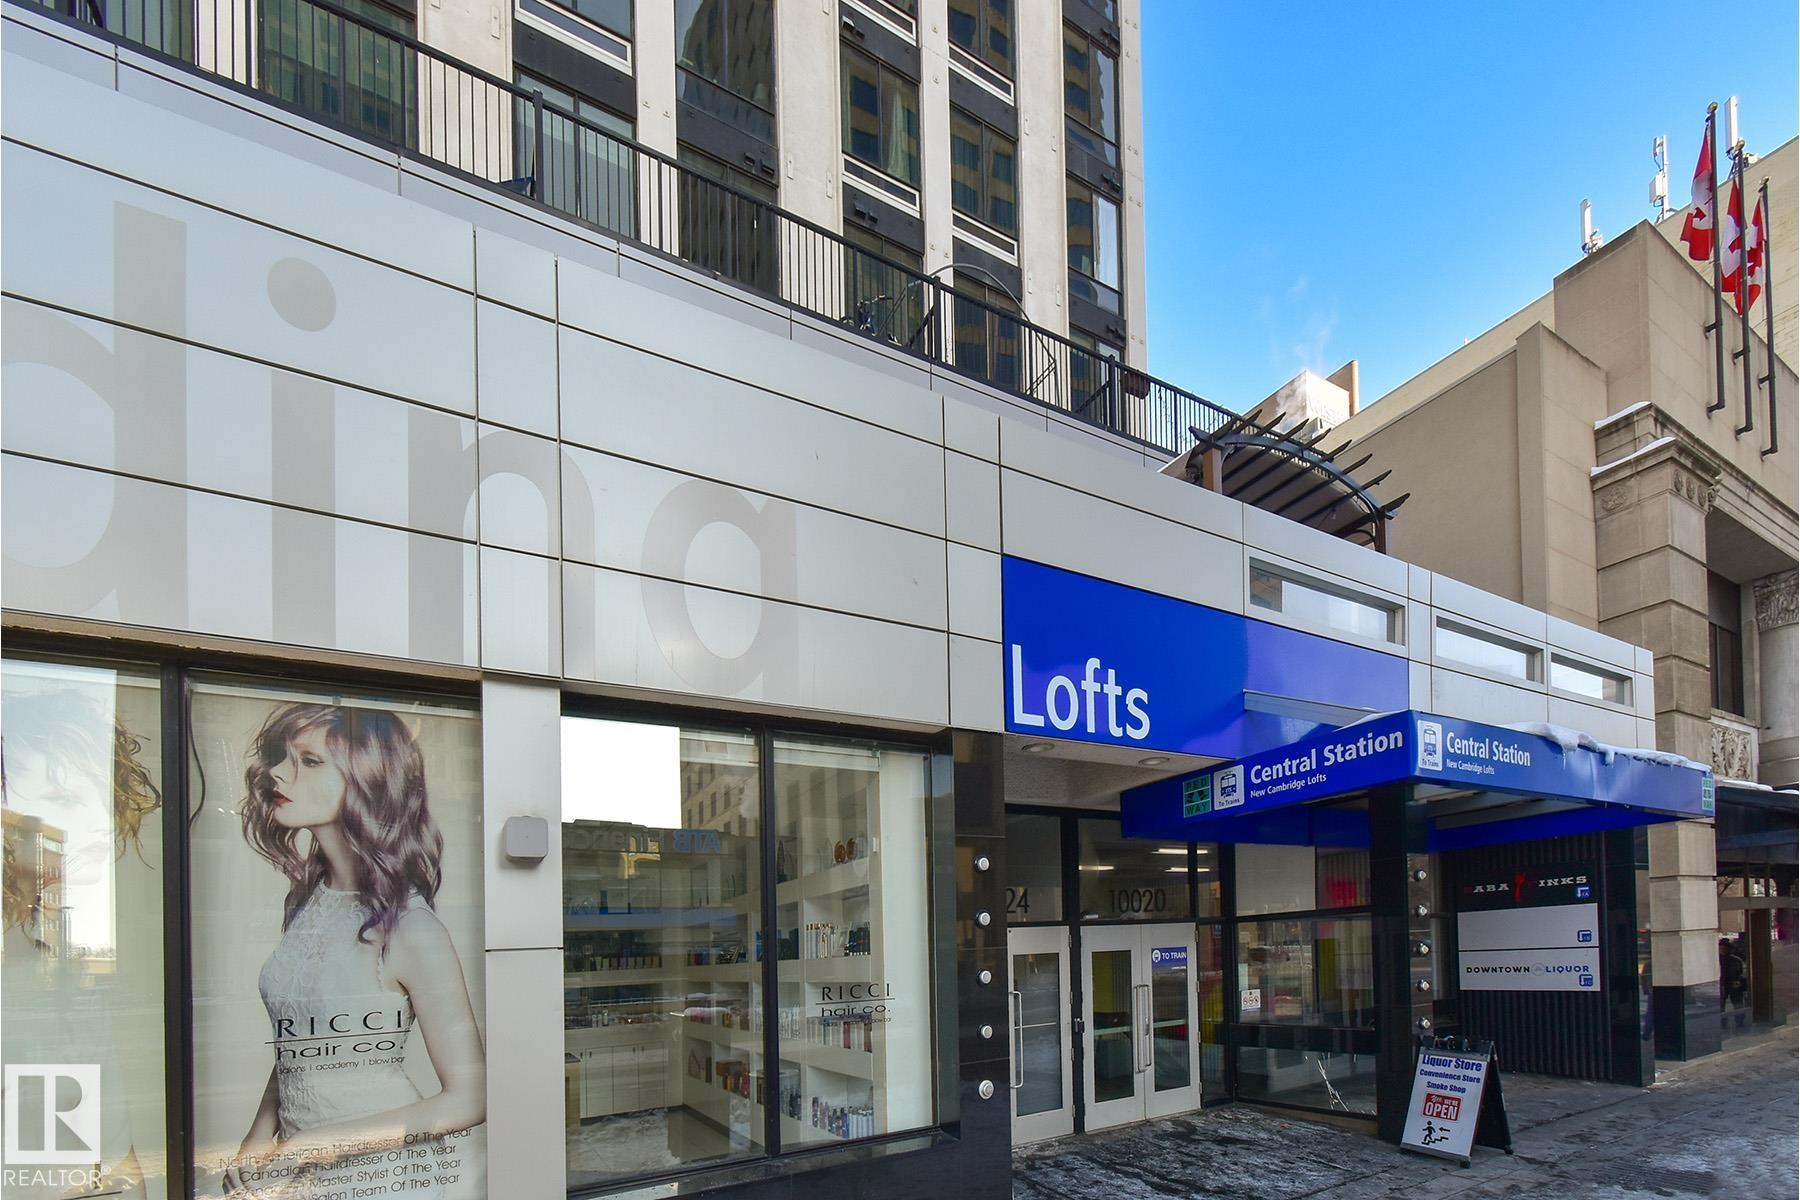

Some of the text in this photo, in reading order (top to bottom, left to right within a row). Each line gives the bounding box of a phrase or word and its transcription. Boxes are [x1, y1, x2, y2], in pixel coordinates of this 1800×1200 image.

[1011, 644, 1151, 740] Lofts
[1250, 730, 1403, 785] Central Station
[1446, 731, 1531, 767] Central Station
[1446, 758, 1495, 775] New Cambridge Lofts
[1250, 773, 1327, 799] New Cambridge Lofts
[1185, 801, 1208, 815] WAY
[1226, 798, 1240, 807] Trains
[1006, 887, 1030, 914] 24
[1110, 888, 1167, 914] 10020
[1161, 951, 1187, 960] TO TRAIN
[1466, 965, 1590, 974] DOWNTOWN LIQUOR
[822, 983, 890, 1001] RICCI
[821, 1004, 891, 1018] hair co.
[277, 1010, 402, 1038] RICCI
[277, 1040, 404, 1060] hair co.
[278, 1056, 406, 1075] salons academy blow bar
[1422, 1054, 1483, 1072] Liquor Store
[1420, 1068, 1482, 1084] Convenience Store
[1426, 1081, 1467, 1094] Smoke Shop
[1425, 1102, 1458, 1120] OPEN
[333, 1137, 403, 1157] Hairdresser
[403, 1132, 420, 1145] Of
[422, 1129, 445, 1142] The
[446, 1127, 473, 1139] Year
[240, 1143, 457, 1183] Canadian Hairdresser Of The Year
[311, 1174, 354, 1189] Master
[356, 1165, 390, 1183] Stylist
[393, 1164, 408, 1178] Of
[411, 1161, 433, 1175] The
[435, 1158, 462, 1171] Year
[311, 1189, 348, 1200] Salon
[351, 1183, 387, 1199] Team
[390, 1178, 407, 1193] Of
[409, 1175, 431, 1189] The
[433, 1173, 460, 1186] Year
